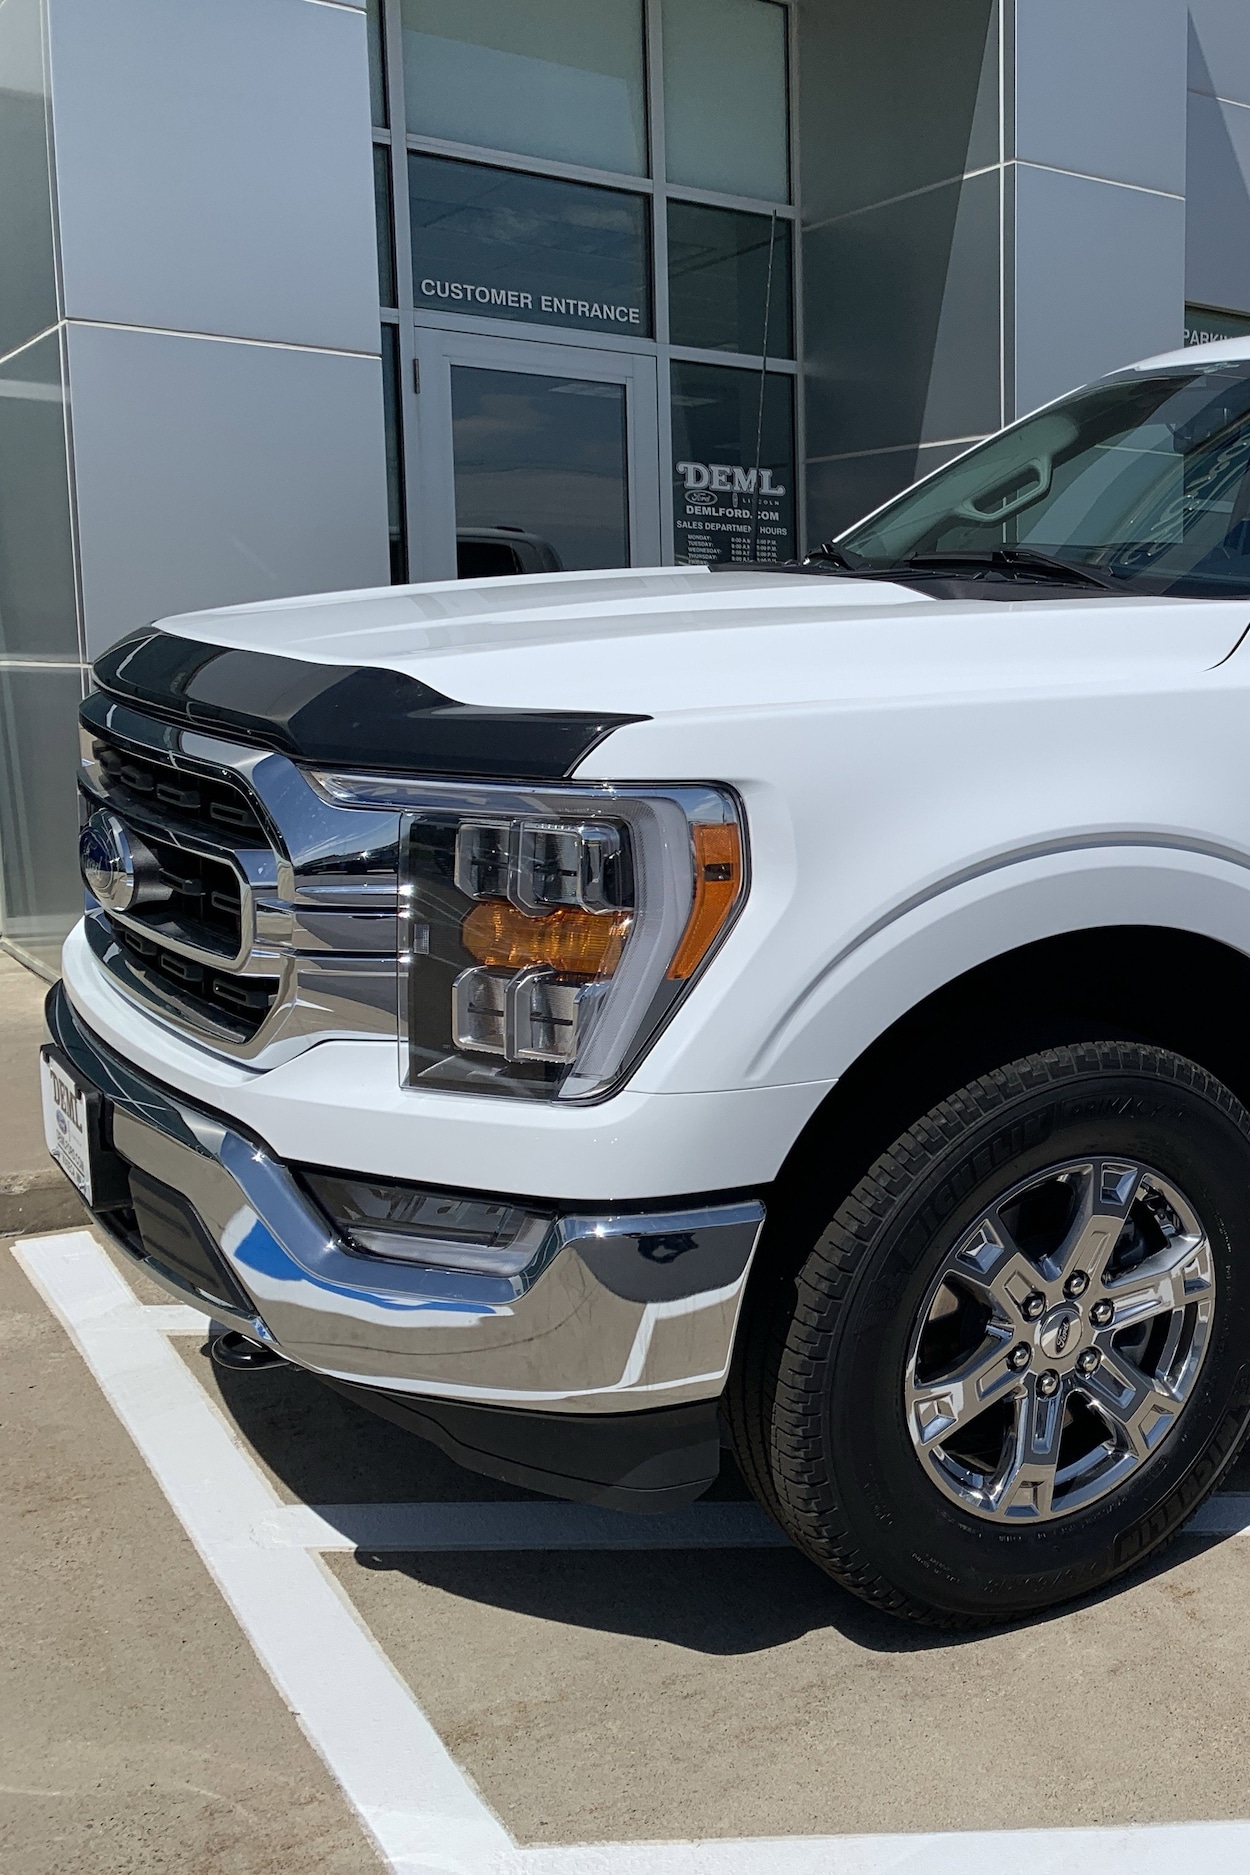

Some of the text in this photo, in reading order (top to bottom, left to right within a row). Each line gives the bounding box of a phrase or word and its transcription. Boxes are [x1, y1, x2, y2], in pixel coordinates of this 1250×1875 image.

[420, 278, 641, 324] CUSTOMER ENTRANCE
[676, 460, 786, 497] DEML
[676, 520, 787, 536] SALES DEPARTMEN HOURS
[50, 1069, 83, 1134] DEML
[1056, 1321, 1071, 1348] Ford
